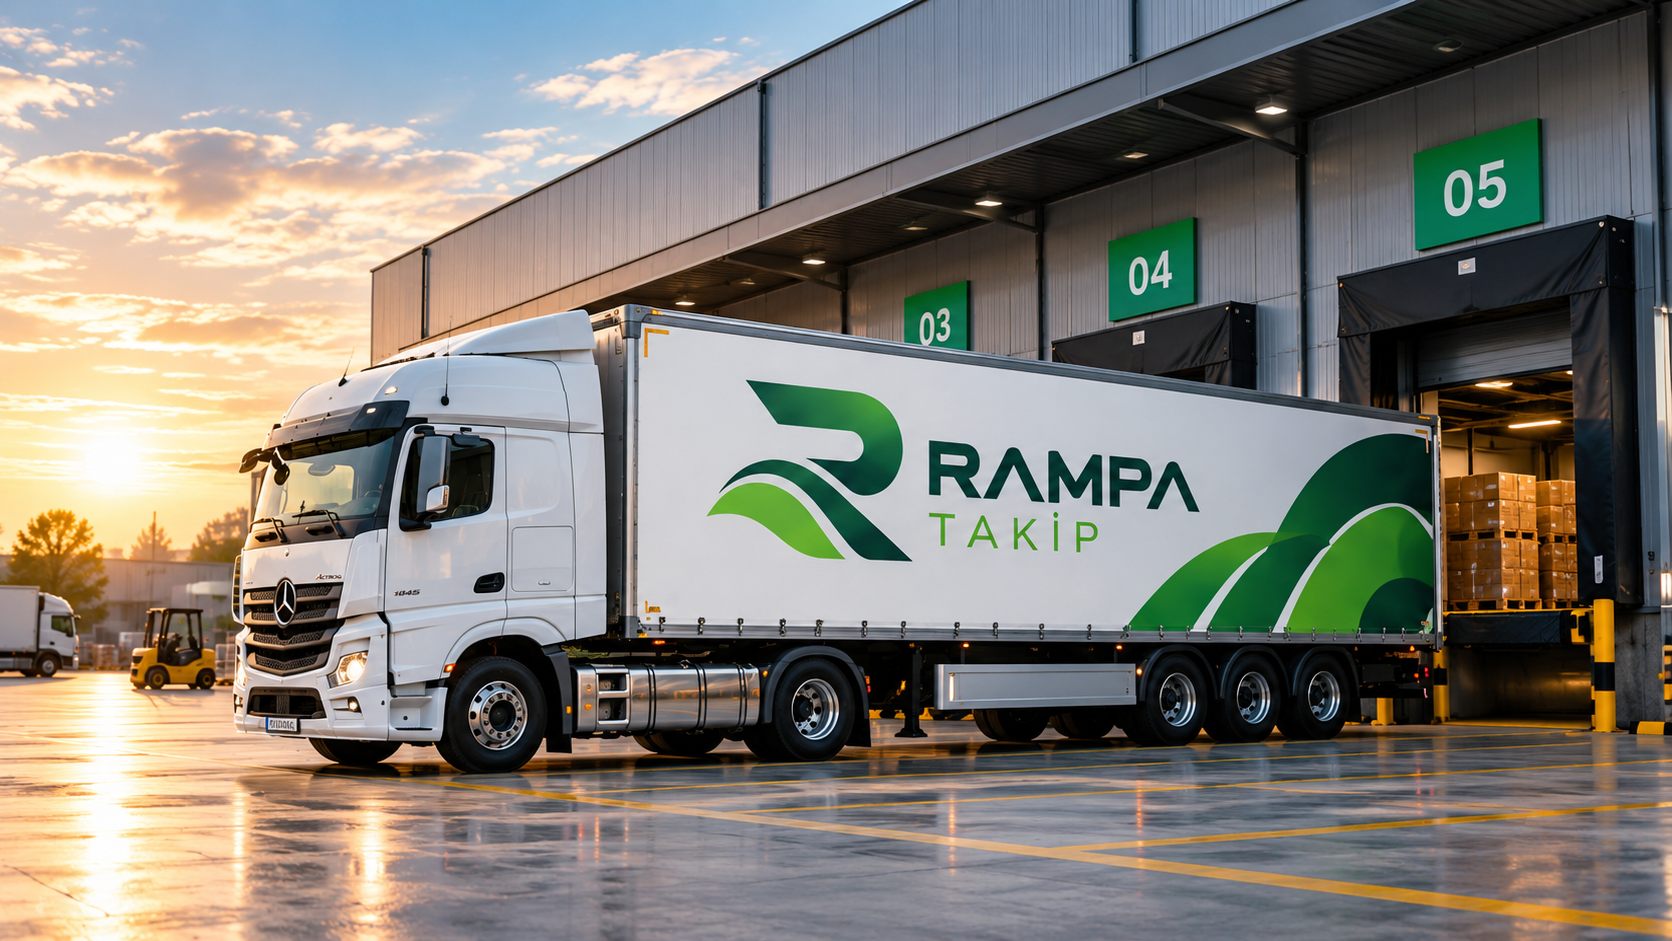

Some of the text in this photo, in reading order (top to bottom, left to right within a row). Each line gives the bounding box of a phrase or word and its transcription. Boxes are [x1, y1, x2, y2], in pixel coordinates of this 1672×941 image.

[1443, 159, 1507, 217] 05
[1128, 249, 1173, 296] 04
[919, 307, 951, 346] 03
[929, 440, 1200, 512] RAMPA
[929, 513, 1099, 553] TAKİP
